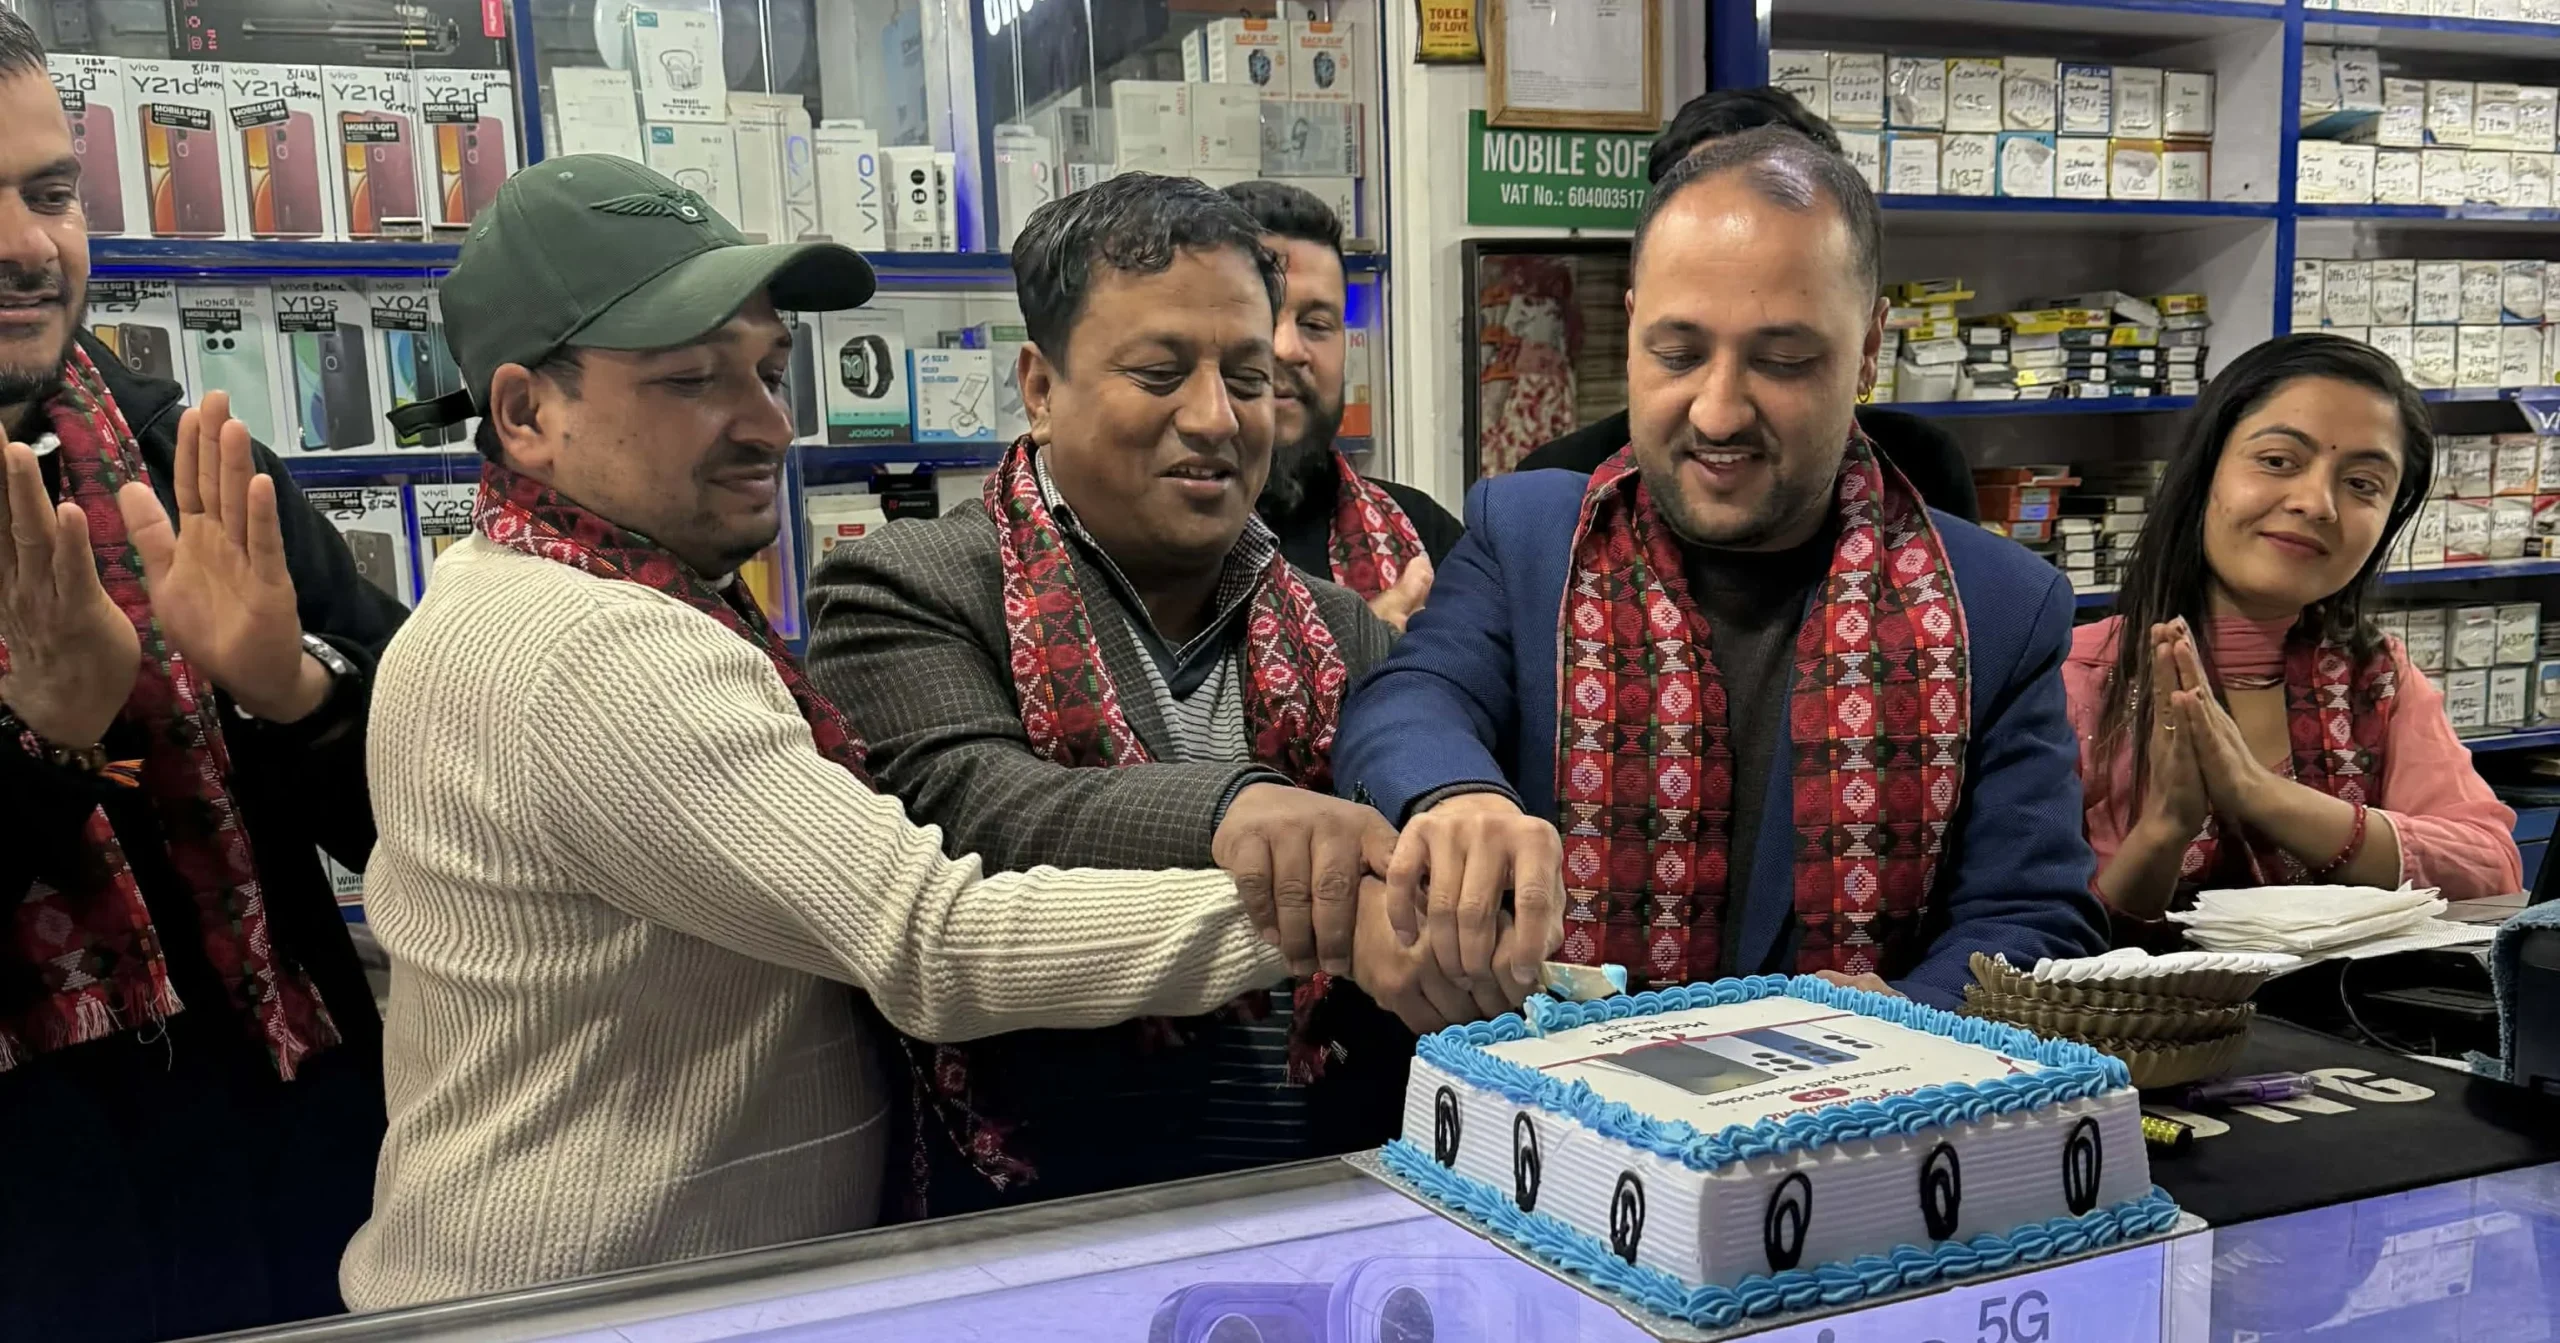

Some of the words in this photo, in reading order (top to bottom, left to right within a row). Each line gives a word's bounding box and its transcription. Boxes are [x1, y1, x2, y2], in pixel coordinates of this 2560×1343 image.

[1428, 8, 1468, 20] TOKEN
[1429, 22, 1441, 32] OF
[1444, 22, 1469, 33] LOVE
[129, 64, 160, 72] vivo
[230, 67, 260, 76] vivo
[49, 72, 96, 91] 21d
[329, 72, 358, 80] vivo
[424, 75, 452, 83] vivo
[131, 76, 199, 95] Y21d
[233, 79, 296, 98] Y21d
[331, 84, 395, 101] Y21d
[426, 86, 488, 103] Y21d
[154, 104, 185, 117] MOBILE
[186, 108, 208, 118] SOFT
[233, 104, 263, 117] MOBILE
[264, 101, 284, 111] SOFT
[425, 104, 454, 112] MOBILE
[455, 104, 475, 112] SOFT
[345, 124, 375, 132] MOBILE
[375, 123, 395, 132] SOFT
[1482, 131, 1586, 176] MOBILE
[1595, 138, 1653, 179] SOF
[856, 153, 878, 234] vivo
[1500, 182, 1530, 204] VAT
[1534, 183, 1564, 206] No.:
[1568, 186, 1645, 210] 604003517
[195, 299, 236, 307] HONOR
[282, 295, 339, 312] Y19s
[185, 310, 215, 319] MOBILE
[216, 310, 238, 319] SOFT
[281, 312, 310, 322] MOBILE
[311, 312, 332, 321] SOFT
[374, 310, 403, 320] MOBILE
[403, 312, 424, 321] SOFT
[308, 491, 337, 500] MOBILE
[338, 491, 358, 499] SOFT
[421, 489, 449, 497] vivo
[422, 517, 450, 525] MOBILE
[1637, 1021, 1710, 1034] Mobile
[1590, 1031, 1638, 1046] Soft
[1831, 1063, 1912, 1082] Samsung
[1804, 1076, 1836, 1089] S25
[1847, 1082, 1871, 1091] on
[1753, 1084, 1807, 1099] Series
[1707, 1092, 1755, 1108] Sales
[1976, 1289, 2050, 1343] 5G
